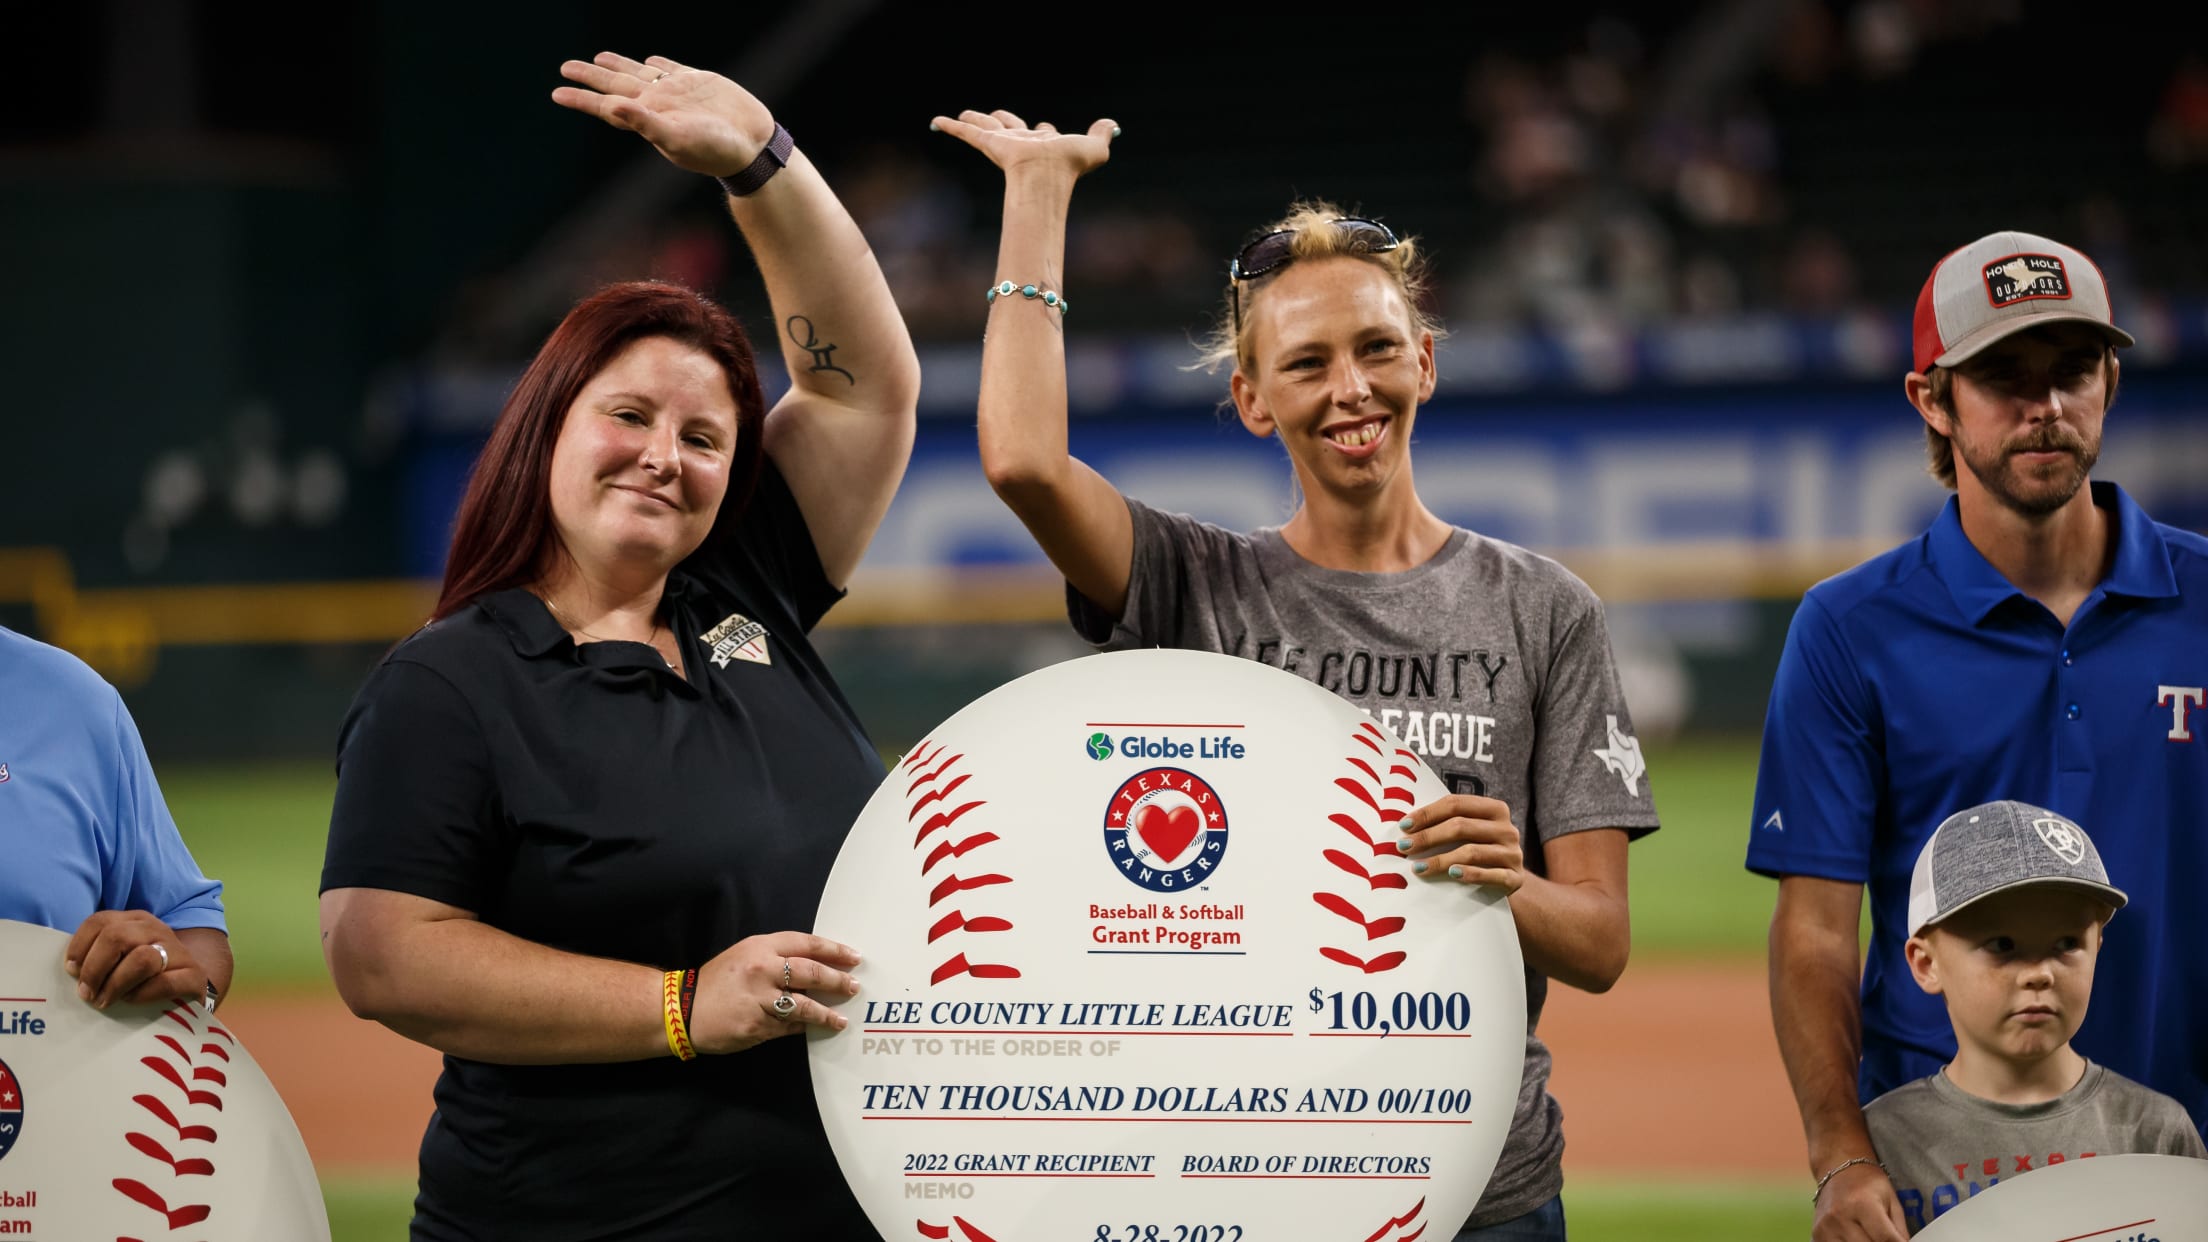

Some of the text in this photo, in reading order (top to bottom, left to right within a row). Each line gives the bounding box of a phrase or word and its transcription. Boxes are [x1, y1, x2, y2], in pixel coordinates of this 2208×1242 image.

[2030, 259, 2061, 270] HOLE
[728, 623, 762, 645] STARS
[1318, 650, 1506, 702] COUNTY
[2157, 685, 2207, 743] T
[1362, 707, 1495, 763] EAGUE
[1120, 736, 1245, 759] Globe Life
[1121, 773, 1211, 804] TEXAS
[1112, 838, 1221, 887] RANGERS
[1089, 904, 1244, 920] Baseball & Softball
[1092, 926, 1241, 950] Grant Program
[863, 1001, 1293, 1027] LEE COUNTY LITTLE LEAGUE
[1308, 988, 1471, 1038] $10,000
[862, 1038, 1121, 1057] PAY TO THE ORDER OF
[863, 1084, 1472, 1114] TEN THOUSAND DOLLARS AND 00/100
[903, 1153, 1155, 1172] 2022 GRANT RECIPIENT
[1181, 1155, 1431, 1174] BOARD OF DIRECTORS
[1954, 1153, 2096, 1179] TEXA
[903, 1182, 975, 1200] MEMO
[1093, 1224, 1243, 1242] 8-28-2022
